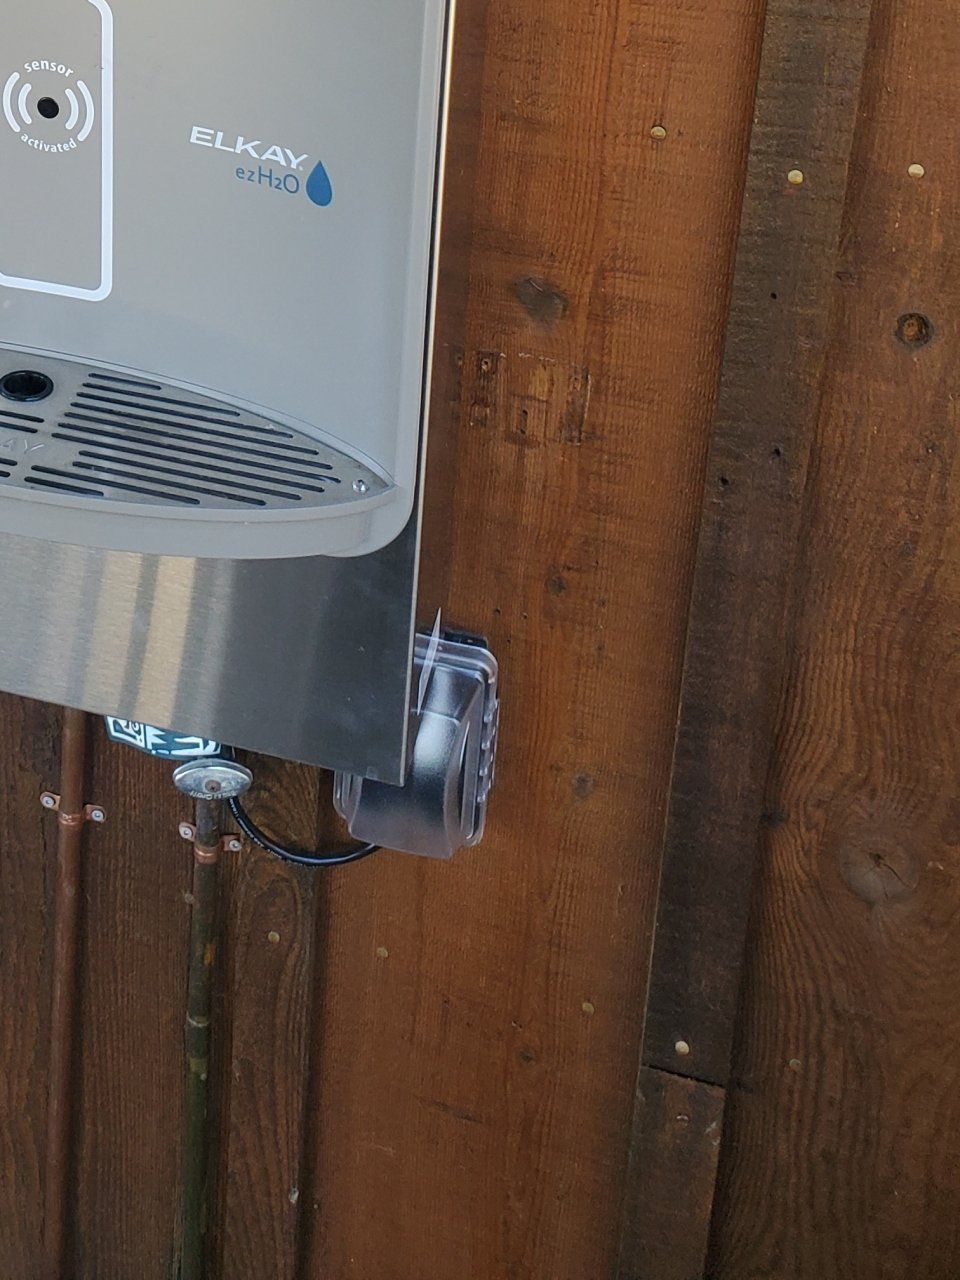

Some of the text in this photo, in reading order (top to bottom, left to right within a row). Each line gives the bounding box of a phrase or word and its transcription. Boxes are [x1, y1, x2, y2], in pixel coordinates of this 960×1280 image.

[24, 60, 74, 77] sensor
[21, 133, 77, 152] activated
[190, 125, 309, 170] ELKAY
